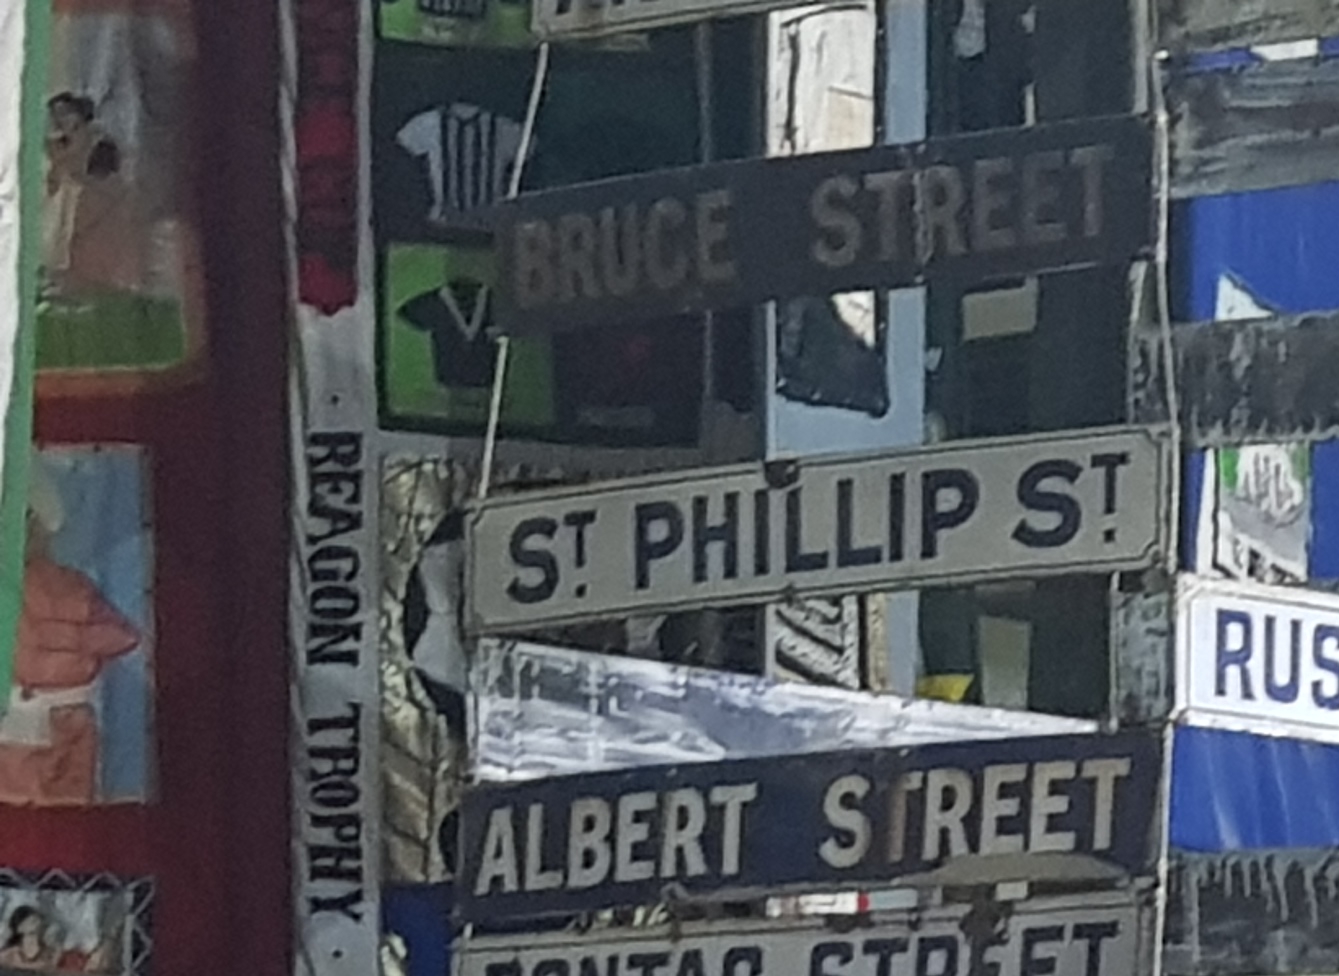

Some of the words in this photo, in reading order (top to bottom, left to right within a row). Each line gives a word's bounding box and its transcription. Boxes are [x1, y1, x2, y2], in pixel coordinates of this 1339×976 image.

[514, 188, 741, 308] BRUCE
[811, 144, 1115, 269] STREET
[306, 430, 363, 667] REAGON
[635, 468, 979, 589] PHILLIP
[308, 703, 363, 923] TROPHY
[475, 783, 759, 895] ALBERT
[820, 757, 1133, 869] STREET
